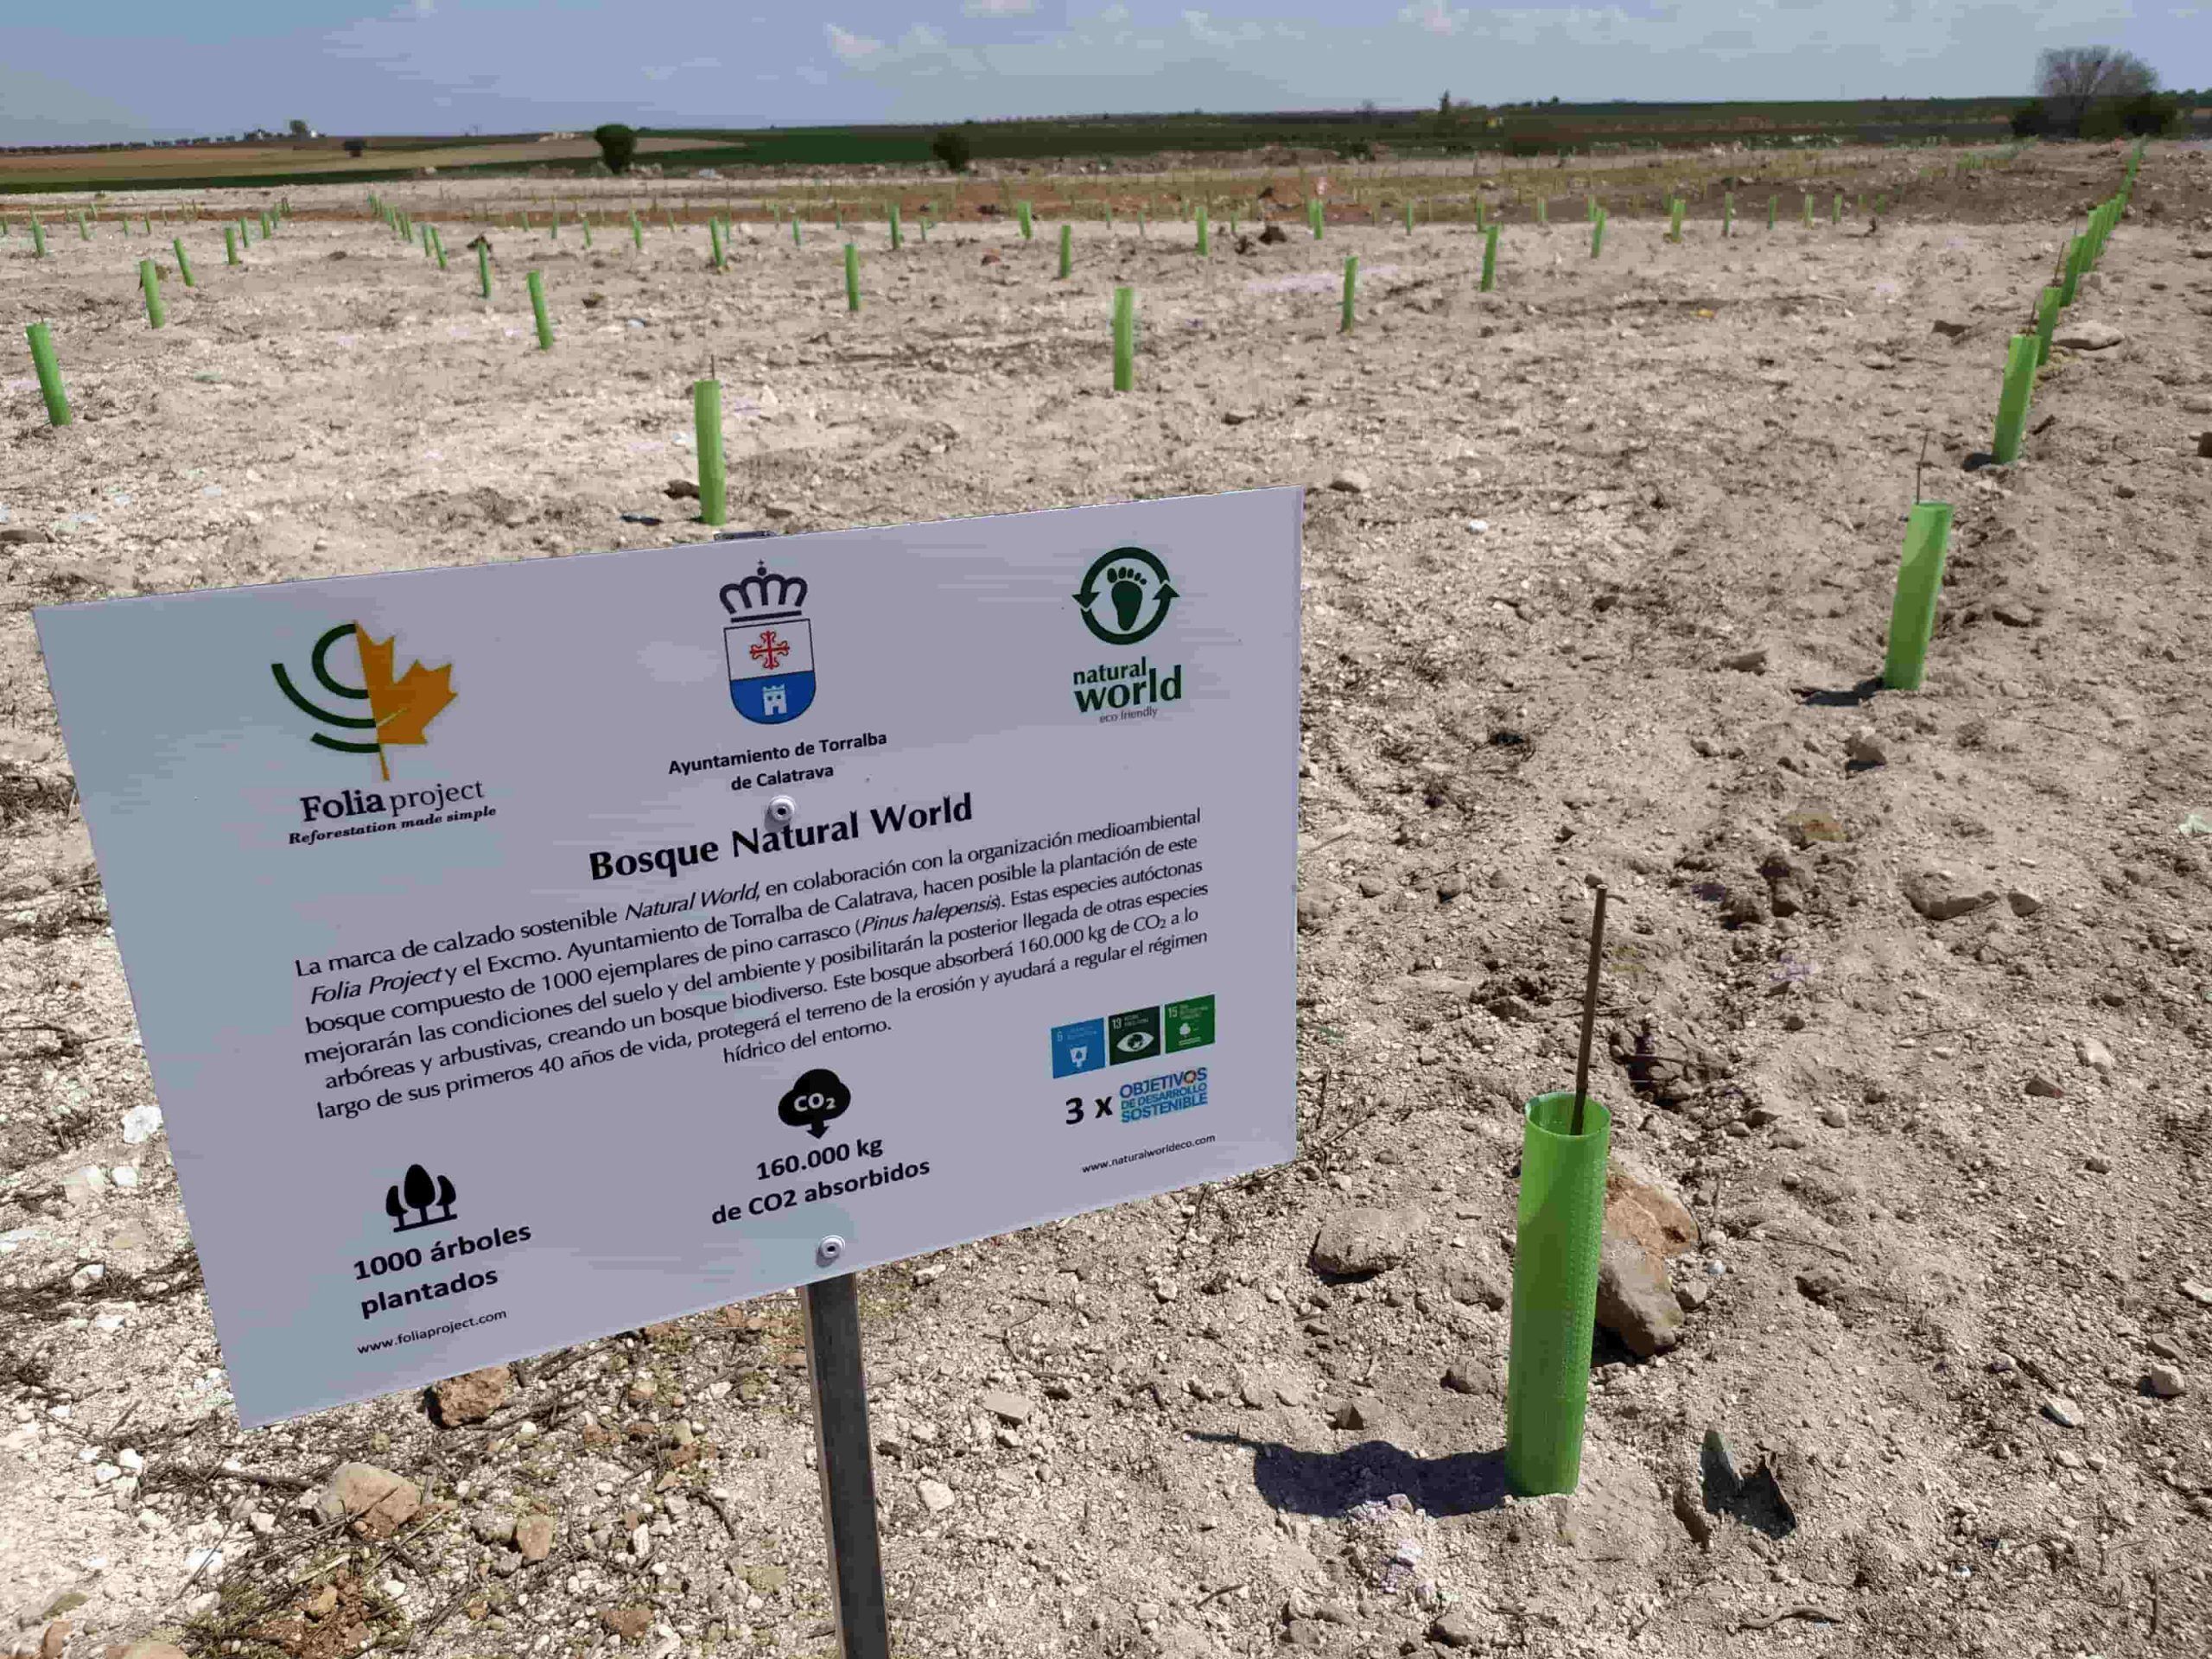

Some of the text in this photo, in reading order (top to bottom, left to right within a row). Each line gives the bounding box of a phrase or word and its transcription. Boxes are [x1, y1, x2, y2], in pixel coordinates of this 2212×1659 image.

[1073, 656, 1146, 684] natural
[1073, 664, 1182, 714] world
[1099, 705, 1158, 723] eco friendly
[668, 732, 887, 776] Ayuntamiento de Torralba
[730, 766, 834, 791] de Calatrava
[299, 780, 485, 823] Folia project
[289, 805, 497, 846] Reforestation made simple
[588, 791, 972, 880] Bosque Natural World
[295, 806, 1201, 977] La marca de calzado sostenible Natural World, en colaboración con la organización medioambiental
[310, 837, 1198, 1005] Folia Project y el Excmo. Ayuntamiento de Torralba de Calatrava, hacen posible la plantación de este
[305, 861, 1203, 1034] bosque compuesto de 1000 ejemplares de pino carrasco (Pinus halepensis). Estas especies autóctonas
[304, 883, 1209, 1065] mejorarán las condiciones del suelo y del ambiente y posibilitarán la posterior llegada de otras especies
[325, 1061, 416, 1090] arbóreas
[419, 1057, 433, 1076] y
[439, 1037, 542, 1067] arbustivas,
[548, 1016, 626, 1046] creando
[631, 1014, 656, 1029] un
[659, 1000, 728, 1024] bosque
[731, 982, 828, 1009] biodiverso.
[833, 973, 867, 990] Este
[869, 961, 931, 983] bosque
[935, 940, 1014, 971] absorberá
[1020, 928, 1084, 954] 160.000
[1088, 925, 1107, 944] kg
[1110, 919, 1130, 937] de
[1170, 913, 1180, 925] a
[1184, 906, 1198, 923] lo
[316, 931, 1208, 1120] largo de sus primeros 40 años de vida, protegerá el terreno de la erosión y ayudará a regular el régimen
[722, 1020, 892, 1064] hídrico del entorno.
[1119, 1066, 1207, 1099] OBJETIVOS
[1121, 1082, 1207, 1109] DE DESARROLLO
[1065, 1096, 1113, 1125] 3 x
[1121, 1091, 1207, 1124] SOSTENIBLE
[756, 1138, 883, 1181] 160.000 kg
[1082, 1135, 1216, 1173] www.naturalworldeco.com
[711, 1160, 930, 1225] de CO2 absorbidos
[353, 1225, 531, 1281] 1000 árboles
[360, 1270, 499, 1320] plantados
[357, 1310, 507, 1354] www.foliaproject.com
